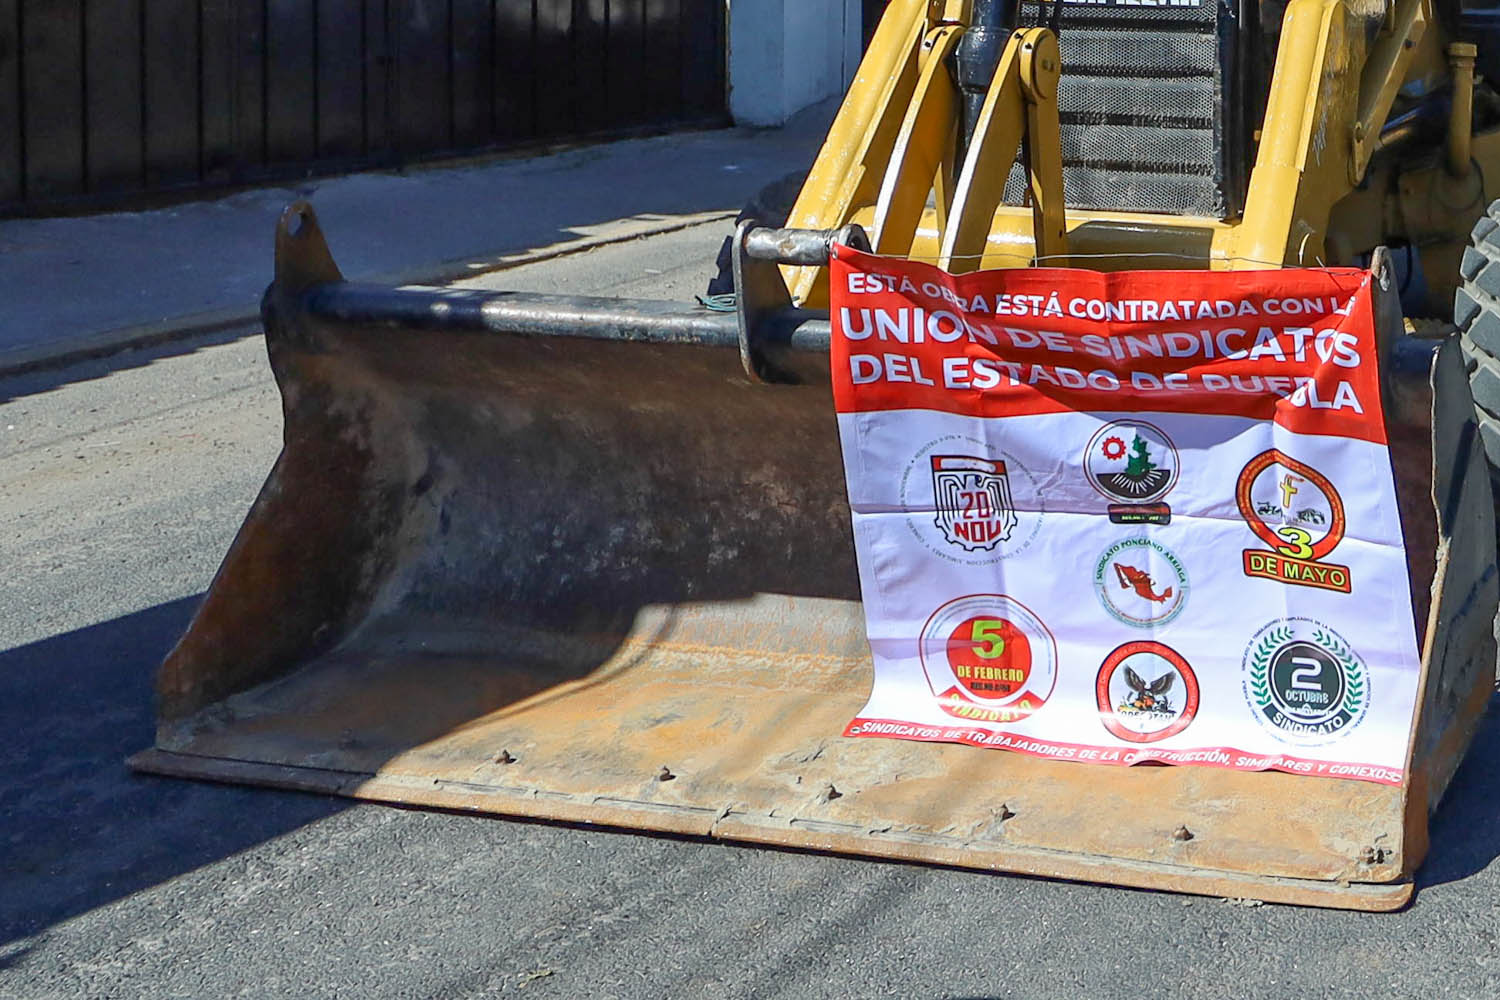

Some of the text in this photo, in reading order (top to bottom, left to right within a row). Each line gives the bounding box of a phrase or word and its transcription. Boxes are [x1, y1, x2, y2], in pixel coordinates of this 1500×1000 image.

[848, 272, 918, 296] ESTÁ
[922, 282, 990, 313] OBRA
[996, 291, 1064, 318] ESTÁ
[1068, 298, 1259, 323] CONTRATADA
[1263, 297, 1324, 316] CON
[840, 307, 1362, 369] UNION DE SINDICATOS
[849, 352, 935, 387] DEL
[943, 356, 1121, 392] ESTADO
[1131, 370, 1189, 392] DE
[960, 491, 991, 520] 20
[953, 519, 1002, 543] NOV
[1277, 526, 1314, 561] 3
[1120, 538, 1163, 553] PONCIANO
[1165, 552, 1187, 583] ARRIAGA
[1250, 555, 1347, 587] DE MAYO
[970, 619, 1006, 660] 5
[957, 665, 1024, 682] DE FEBRERO
[1290, 656, 1322, 691] 2
[1285, 690, 1329, 704] OCTUBRE
[1272, 711, 1344, 736] SINDICATO
[861, 721, 942, 739] SINDICATOS
[944, 729, 964, 740] DE
[966, 732, 1077, 758] TRABAJADORES
[1078, 749, 1098, 760] DE
[1100, 751, 1120, 762] LA
[1317, 763, 1326, 773] Y
